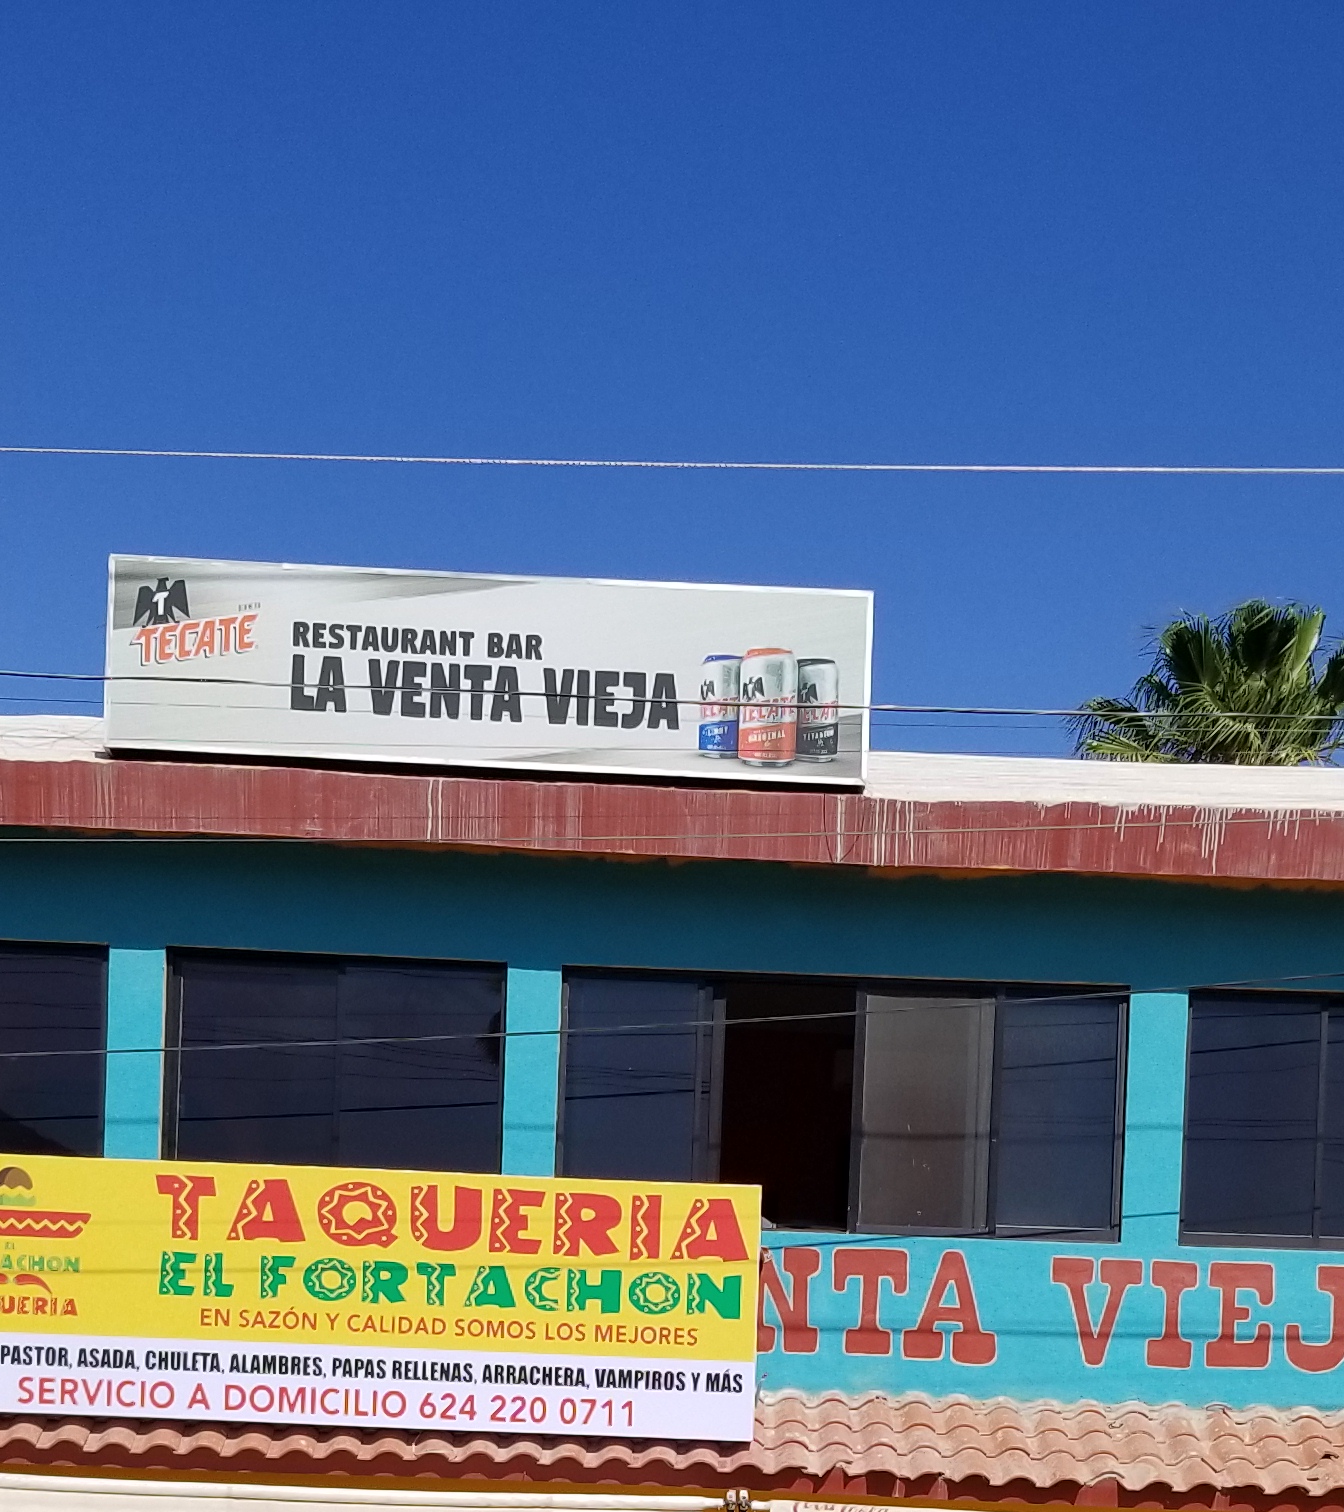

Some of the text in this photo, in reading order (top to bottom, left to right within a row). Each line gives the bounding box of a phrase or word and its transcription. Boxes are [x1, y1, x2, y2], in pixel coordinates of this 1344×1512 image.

[131, 613, 259, 666] TECATE
[292, 621, 543, 660] RESTAURANT BAR
[290, 654, 680, 730] LA VENTA VIEJA
[156, 1174, 750, 1262] TAQUERIA
[159, 1250, 743, 1320] EL FORTACHON
[200, 1307, 699, 1347] EN SAZÓN Y CALIDAD SOMOS LOS MEJORES
[0, 1346, 73, 1370] PASTOR,
[77, 1348, 140, 1372] ASADA,
[145, 1350, 225, 1375] CHULETA,
[229, 1353, 327, 1379] ALAMBRES,
[332, 1357, 387, 1379] PAPAS
[392, 1360, 477, 1384] RELLENAS,
[482, 1364, 590, 1390] ARRACHERA,
[594, 1368, 686, 1391] VAMPIROS
[691, 1371, 702, 1391] Y
[705, 1368, 744, 1394] MÁS
[18, 1376, 635, 1427] SERVICIO A DOMICILIO 624 220 0711
